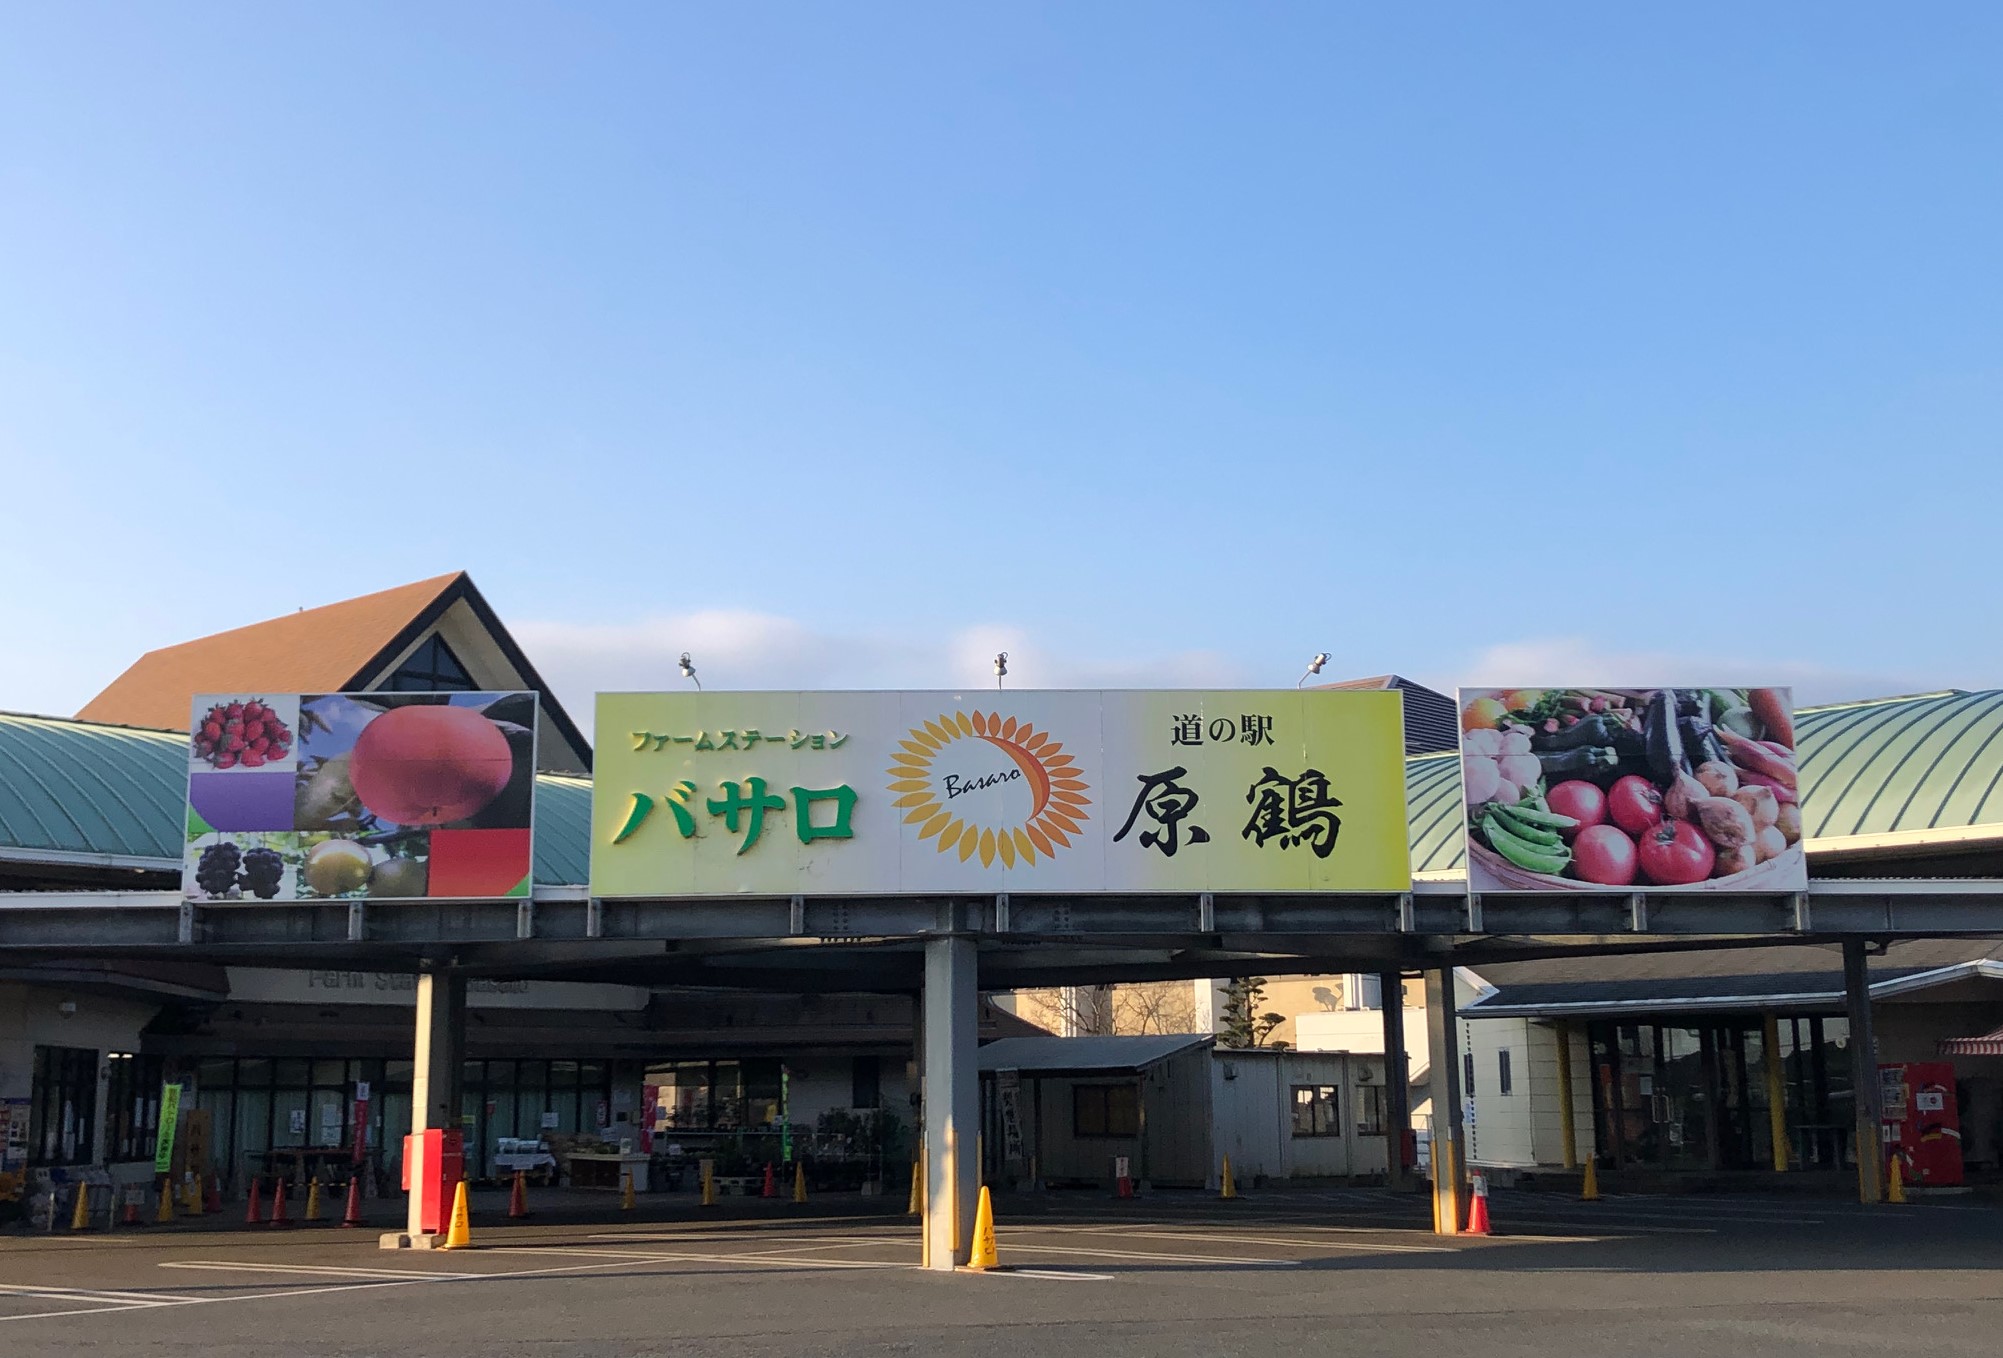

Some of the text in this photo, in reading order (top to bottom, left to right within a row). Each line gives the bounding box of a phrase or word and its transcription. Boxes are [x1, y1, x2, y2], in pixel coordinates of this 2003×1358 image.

[632, 728, 851, 751] ファームステーション
[1170, 713, 1275, 747] 道の駅
[942, 767, 1022, 800] Basaro
[612, 776, 859, 857] バサロ
[1112, 765, 1344, 859] 原鶴
